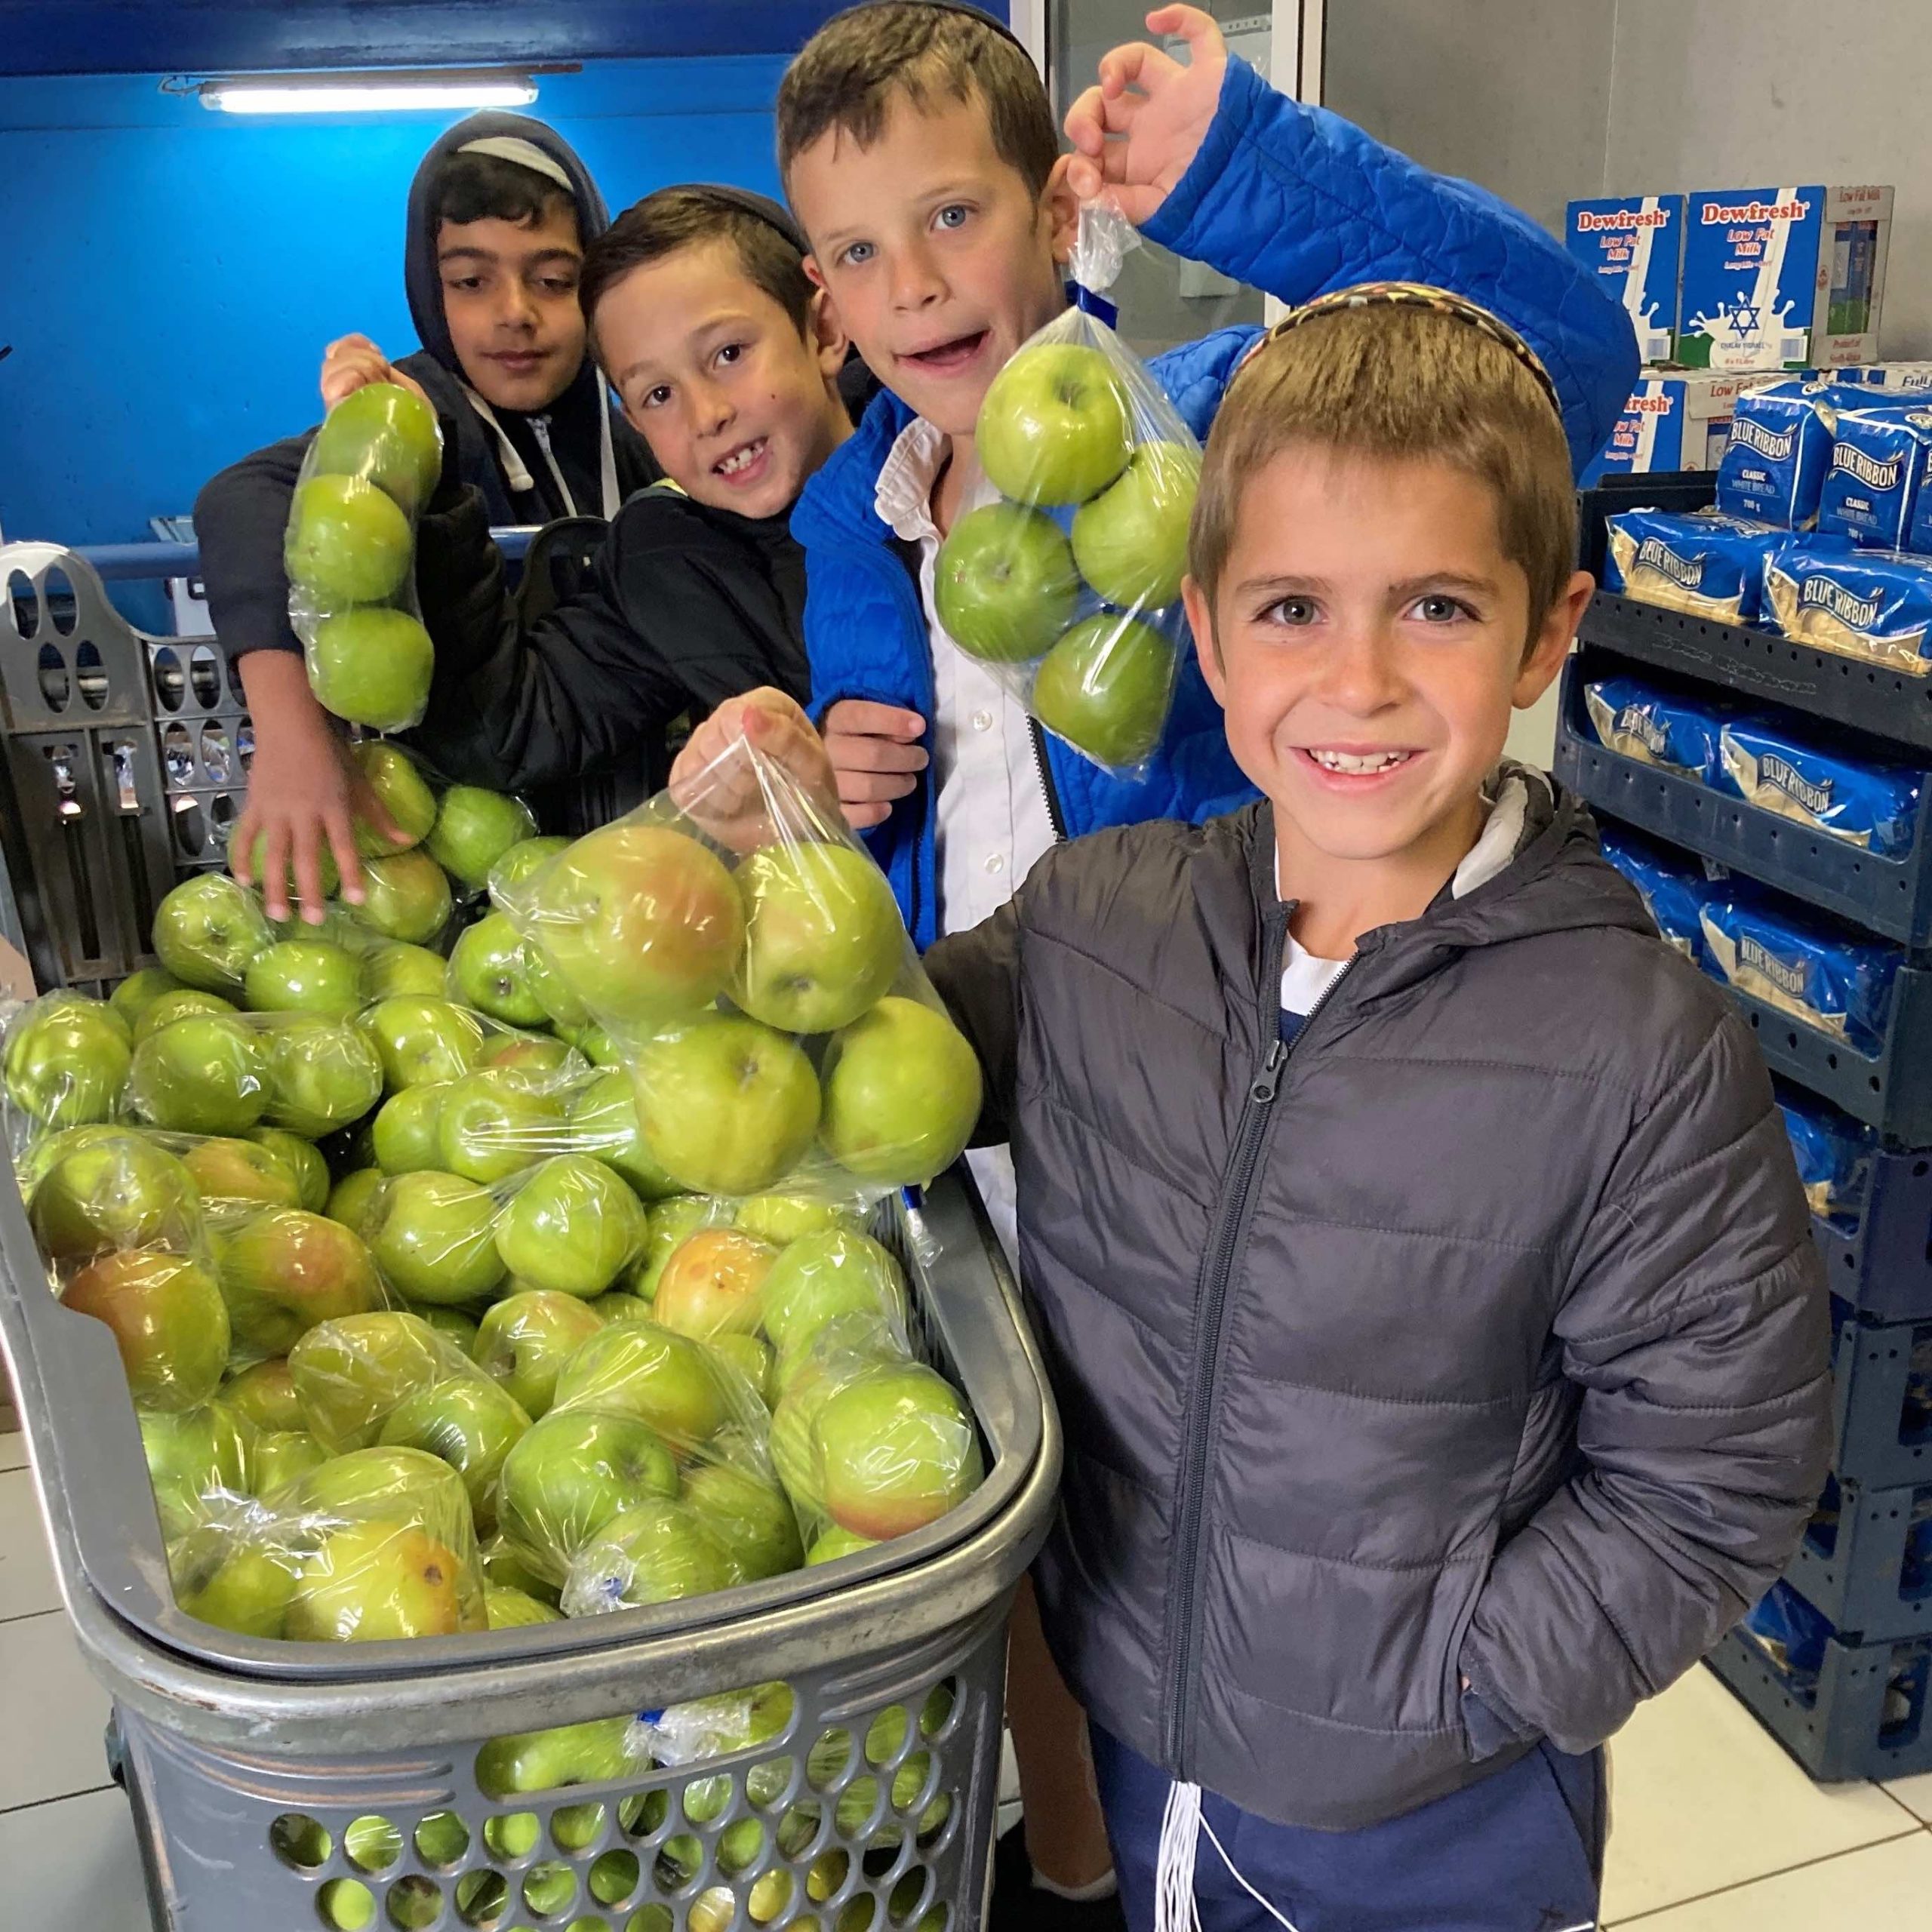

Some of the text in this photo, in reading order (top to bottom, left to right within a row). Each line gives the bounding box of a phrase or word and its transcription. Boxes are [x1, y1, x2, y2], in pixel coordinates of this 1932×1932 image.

[1579, 210, 1666, 230] Dewfresh
[1703, 201, 1804, 223] Dewfresh
[1600, 235, 1641, 248] Low Fat
[1727, 228, 1775, 242] Low Fat
[1607, 248, 1629, 260] Milk
[1735, 242, 1761, 256] Milk
[1710, 386, 1734, 397] Low
[1730, 421, 1792, 457] BLUE RIBBON
[1742, 469, 1766, 481] CLASSIC
[1832, 445, 1857, 472] BLUE
[1856, 454, 1898, 487] RIBBON
[1845, 497, 1869, 512] CLASSIC
[1638, 540, 1702, 586] BLUE RIBBON
[1804, 580, 1878, 626] BLUE RIBBON
[1763, 757, 1829, 813] BLUE RIBBON
[1764, 954, 1804, 993] RIBBON
